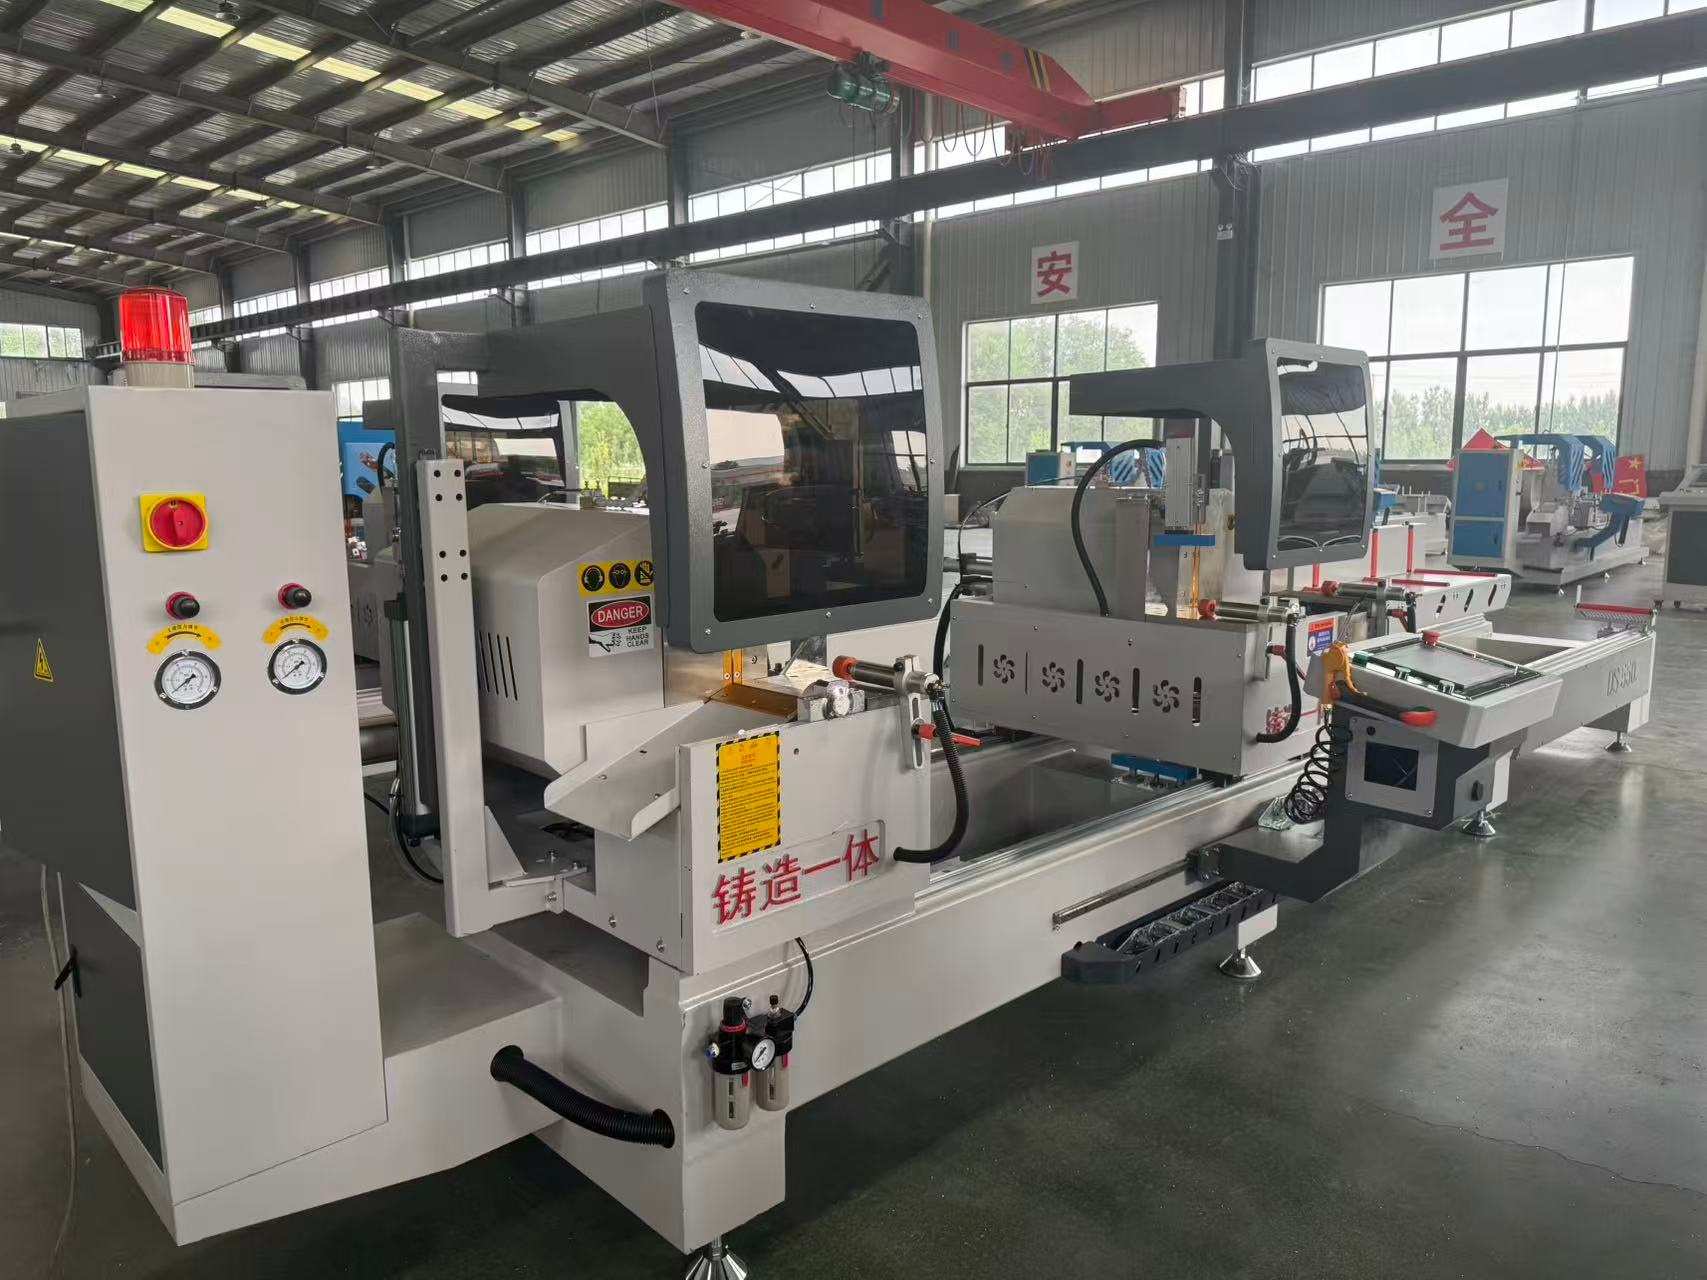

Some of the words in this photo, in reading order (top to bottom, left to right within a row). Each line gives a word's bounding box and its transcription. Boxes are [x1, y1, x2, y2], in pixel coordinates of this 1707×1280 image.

[1440, 192, 1498, 251] 全
[1037, 250, 1072, 297] 安
[597, 605, 644, 623] DANGER
[626, 633, 649, 641] HANDS
[627, 626, 647, 635] KEEP
[627, 640, 649, 648] CLEAR
[712, 828, 880, 925] 铸造一体
